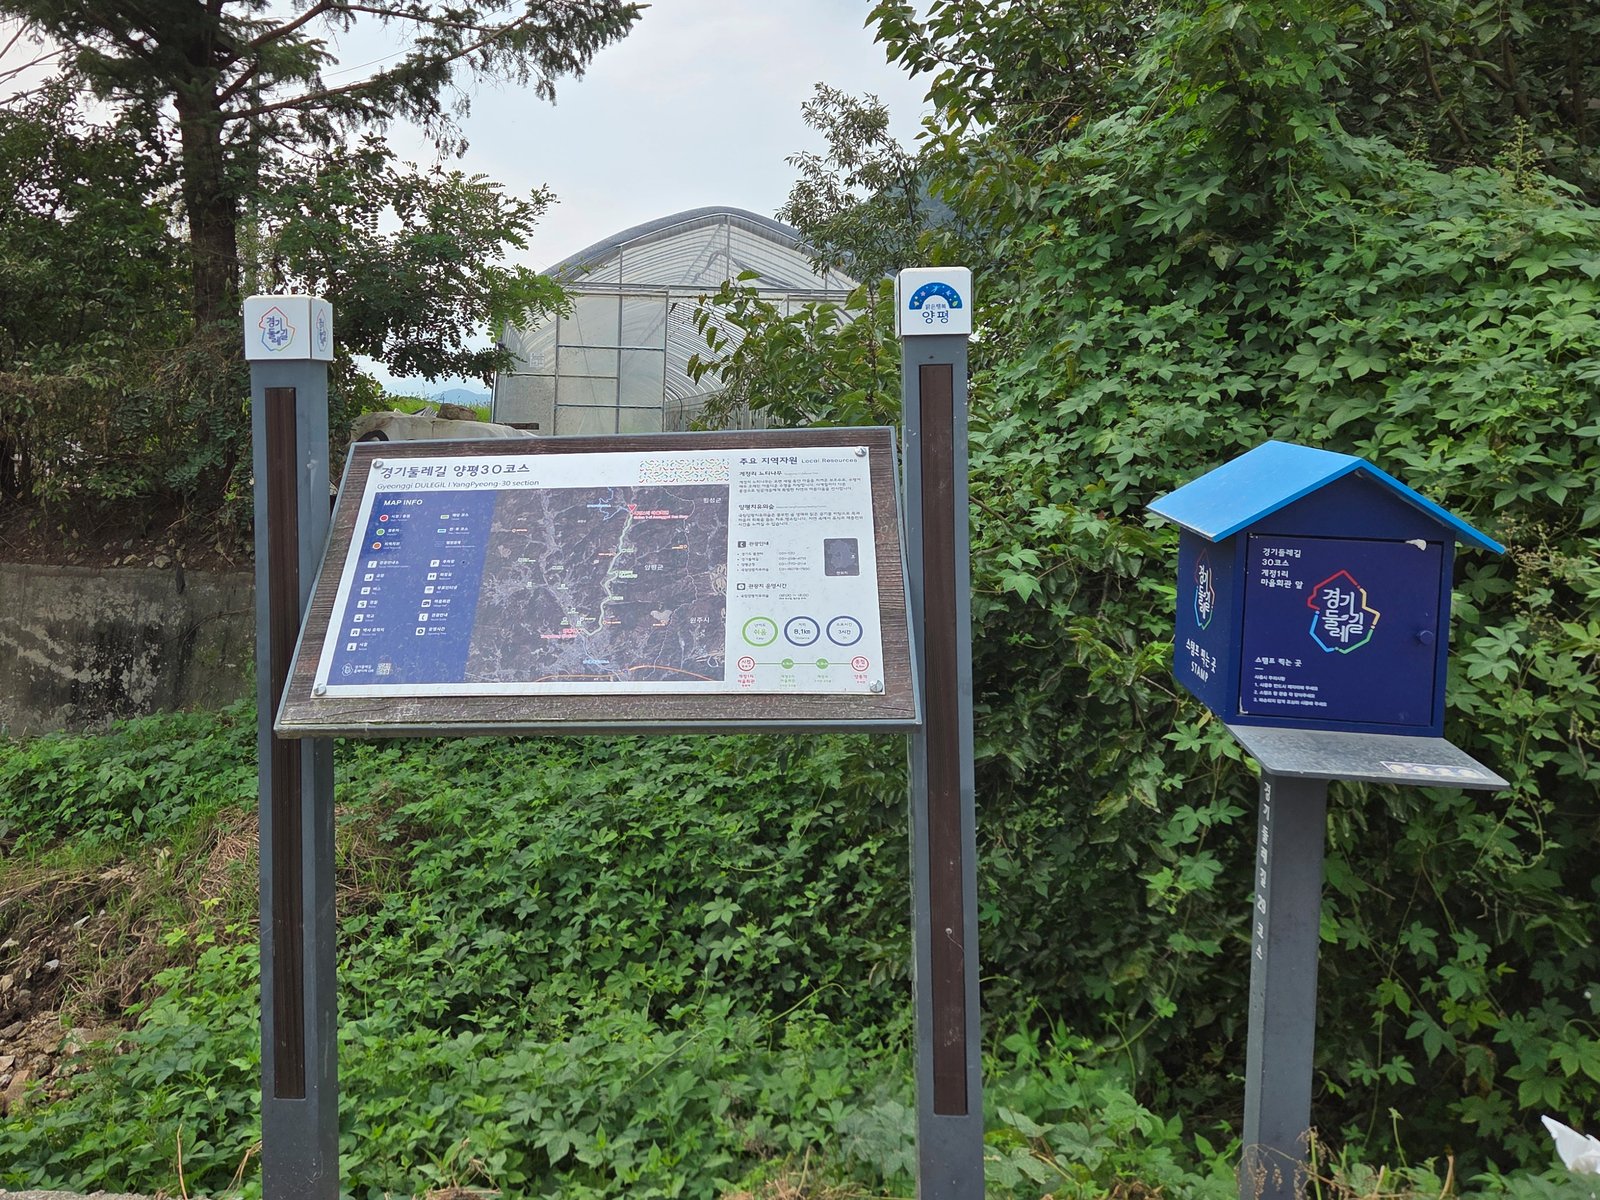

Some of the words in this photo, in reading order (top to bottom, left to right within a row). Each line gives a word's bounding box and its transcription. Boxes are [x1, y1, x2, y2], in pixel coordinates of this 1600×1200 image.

[922, 310, 949, 324] 양평
[740, 457, 758, 465] 주요
[762, 455, 799, 465] 지역자원
[380, 465, 448, 479] 경기둘레길
[453, 464, 530, 477] 양평30코스
[377, 483, 414, 491] Gyeonggi
[512, 479, 540, 487] section
[1262, 547, 1302, 559] 경기둘레길
[1261, 558, 1290, 567] 30코스
[1261, 569, 1289, 578] 계정1리
[1260, 578, 1292, 588] 마을회관
[1295, 580, 1304, 590] 앞
[690, 616, 711, 625] 원주시
[1254, 656, 1276, 665] 스탬프
[1278, 658, 1292, 667] 찍는
[1294, 659, 1303, 667] 곳
[1190, 661, 1210, 683] STAMP
